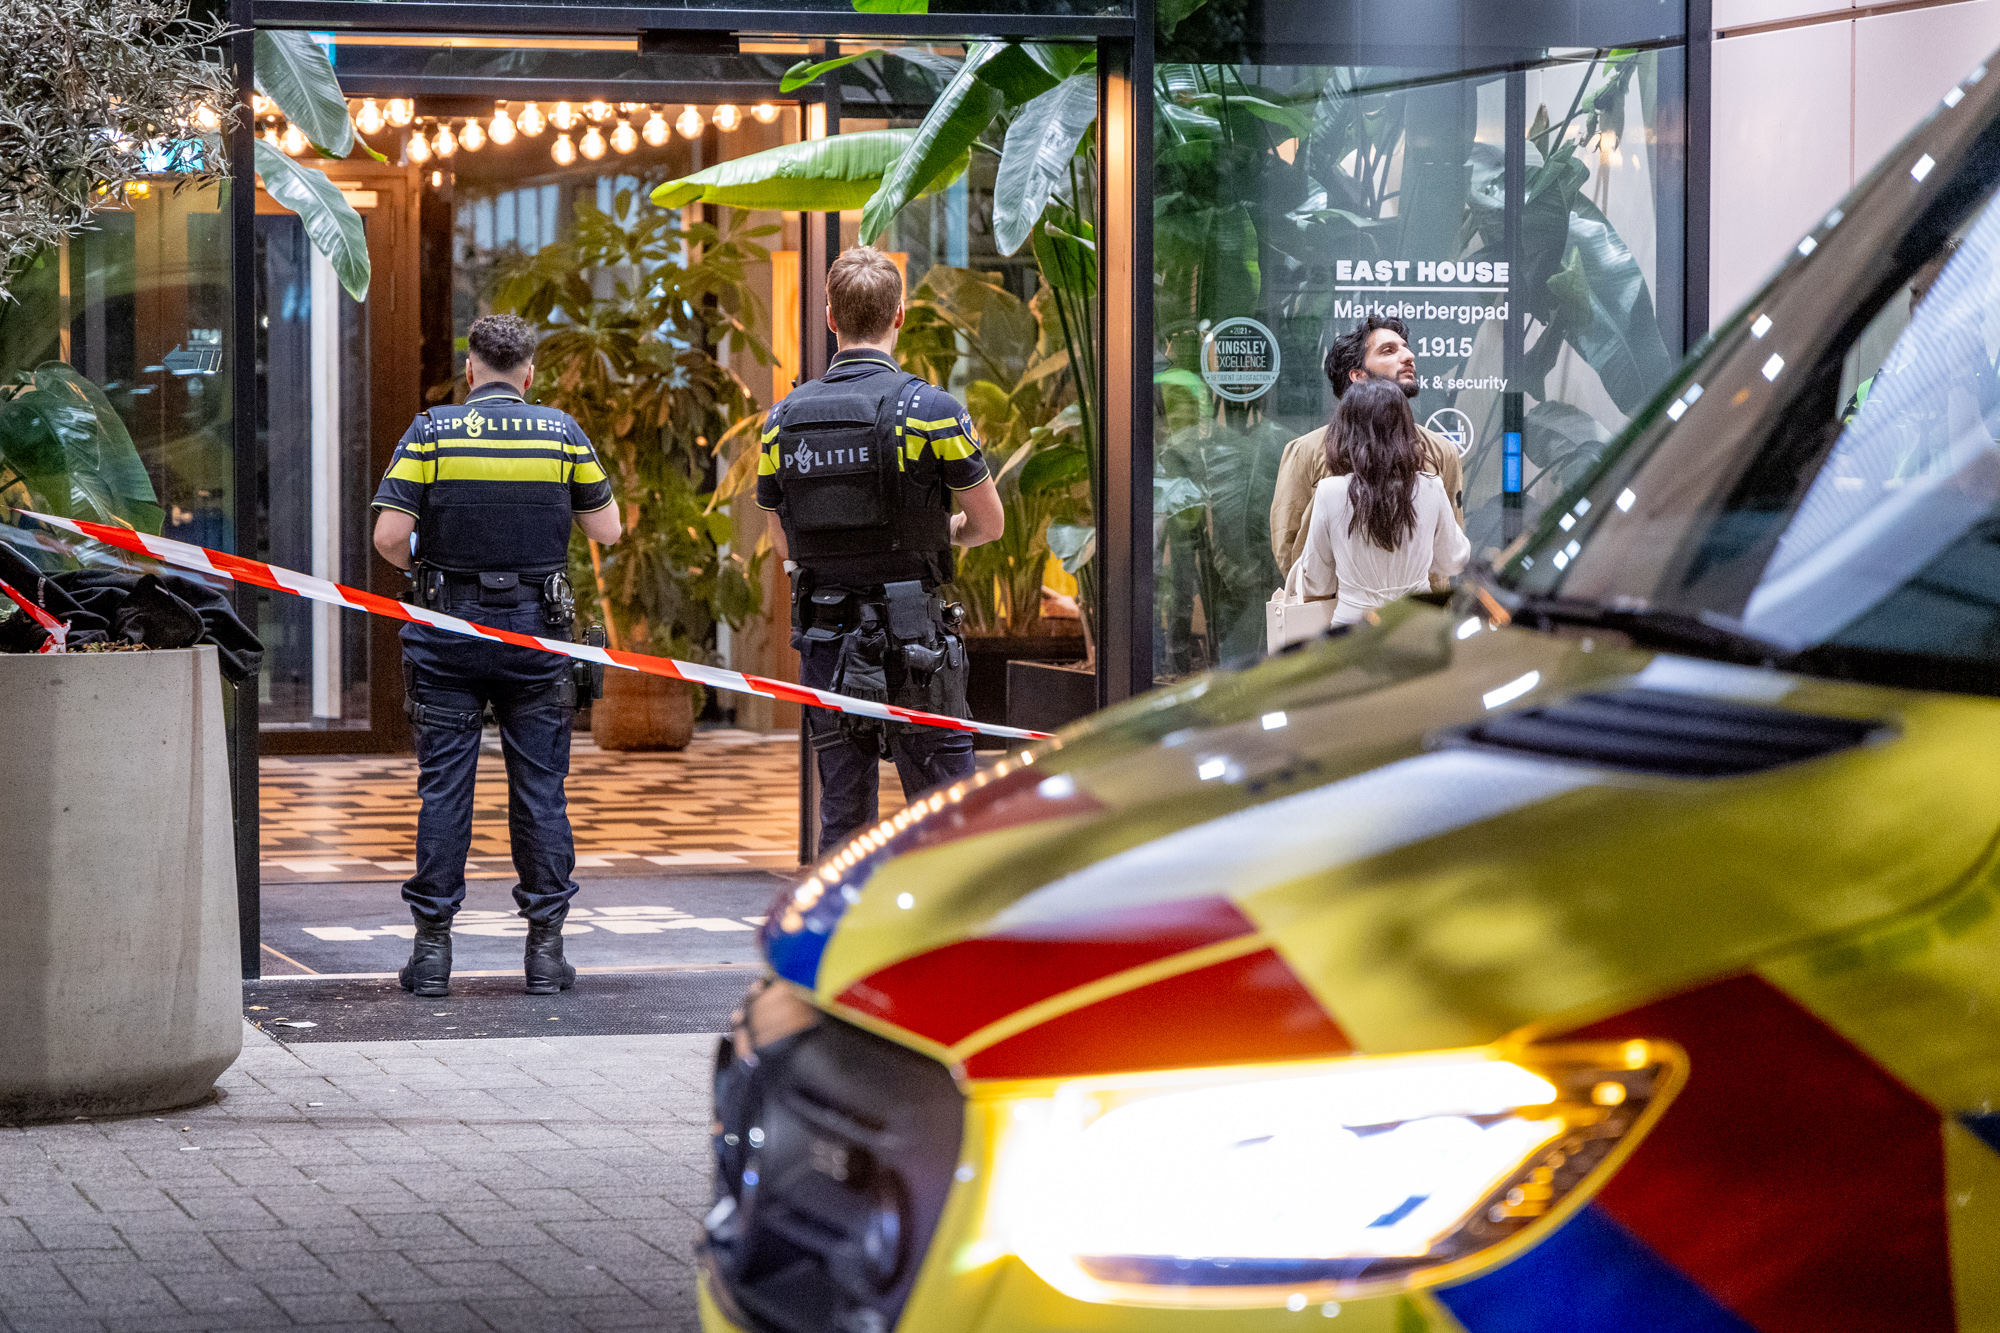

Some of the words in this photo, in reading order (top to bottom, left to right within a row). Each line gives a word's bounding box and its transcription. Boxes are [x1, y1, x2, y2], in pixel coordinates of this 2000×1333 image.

[1336, 260, 1411, 282] EAST
[1417, 261, 1509, 283] HOUSE
[1334, 300, 1509, 324] Markelerbergpad
[1214, 340, 1267, 354] KINGSLEY
[1418, 337, 1473, 358] 1915
[1214, 355, 1267, 368] EXCELLENCE
[1432, 375, 1444, 389] &
[1447, 375, 1508, 392] security
[452, 409, 548, 438] POLITIE
[784, 438, 870, 474] POLITIE
[301, 916, 766, 941] HOM
